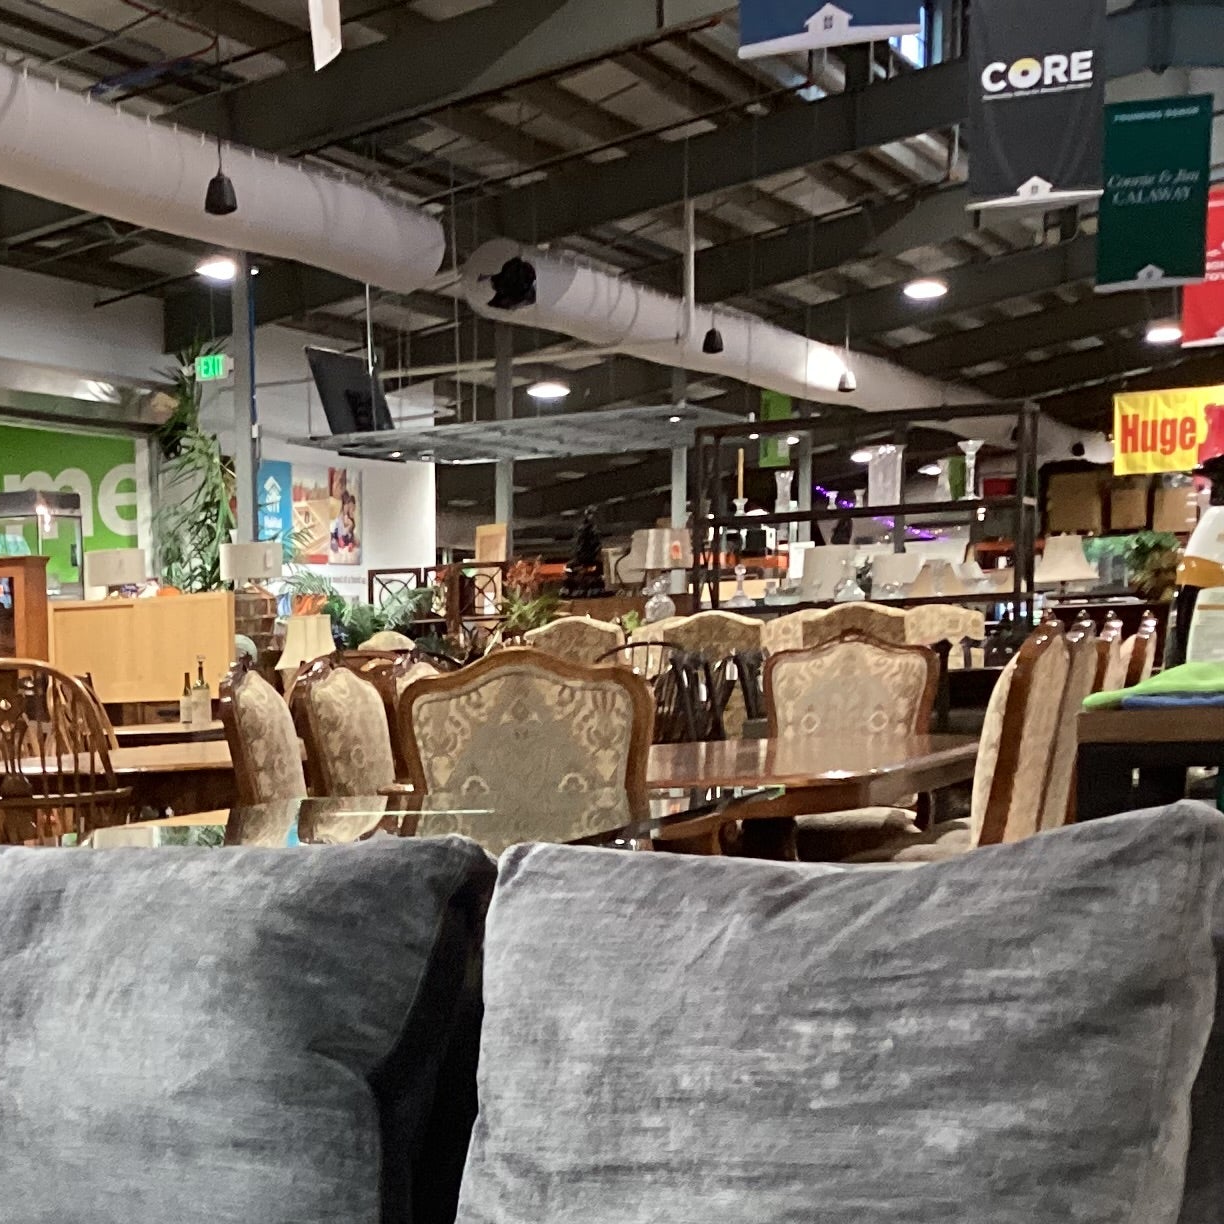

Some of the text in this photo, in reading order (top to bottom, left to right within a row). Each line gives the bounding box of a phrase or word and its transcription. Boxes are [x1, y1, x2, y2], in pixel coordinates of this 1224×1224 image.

[981, 50, 1093, 92] CORE
[201, 356, 223, 377] EXIT
[1120, 413, 1197, 456] Huge
